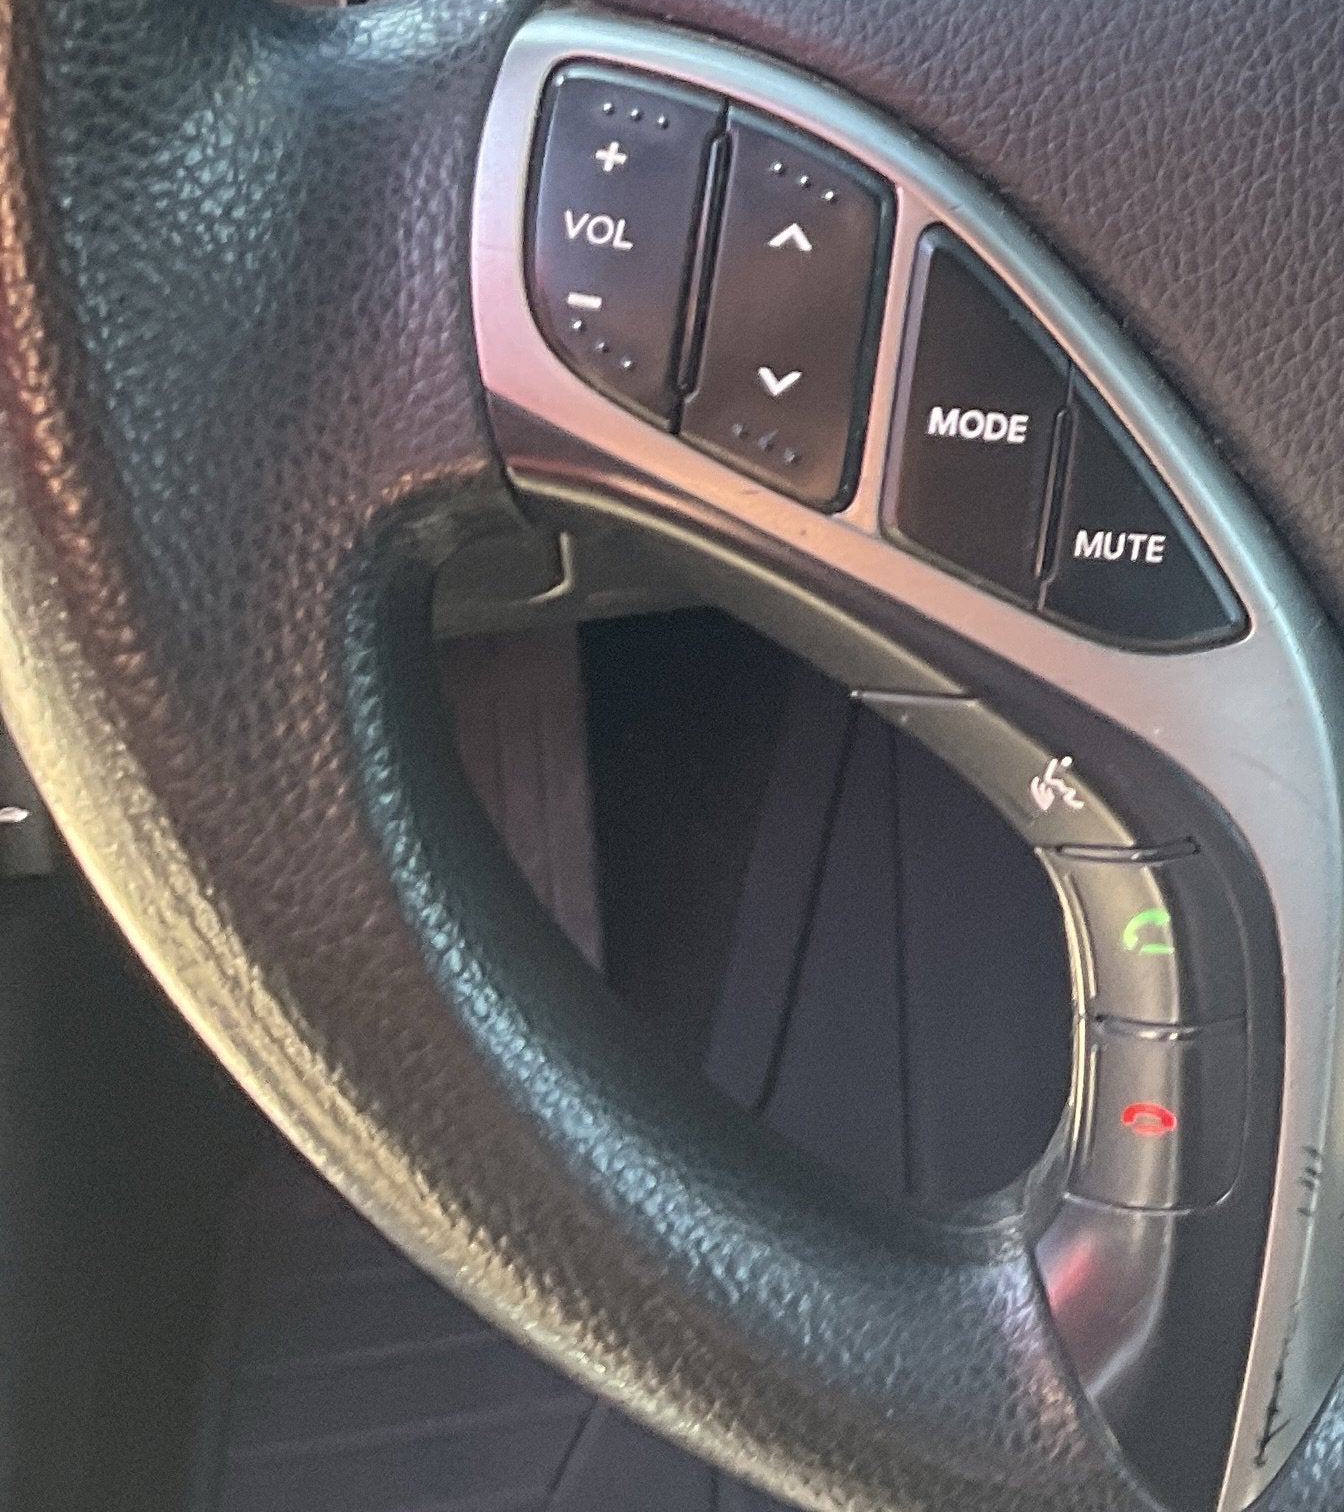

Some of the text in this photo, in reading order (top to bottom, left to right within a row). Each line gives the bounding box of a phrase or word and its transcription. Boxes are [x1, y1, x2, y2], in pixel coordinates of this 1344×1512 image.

[564, 210, 634, 251] VOL
[928, 406, 1029, 445] MODE
[1073, 530, 1166, 564] MUTE
